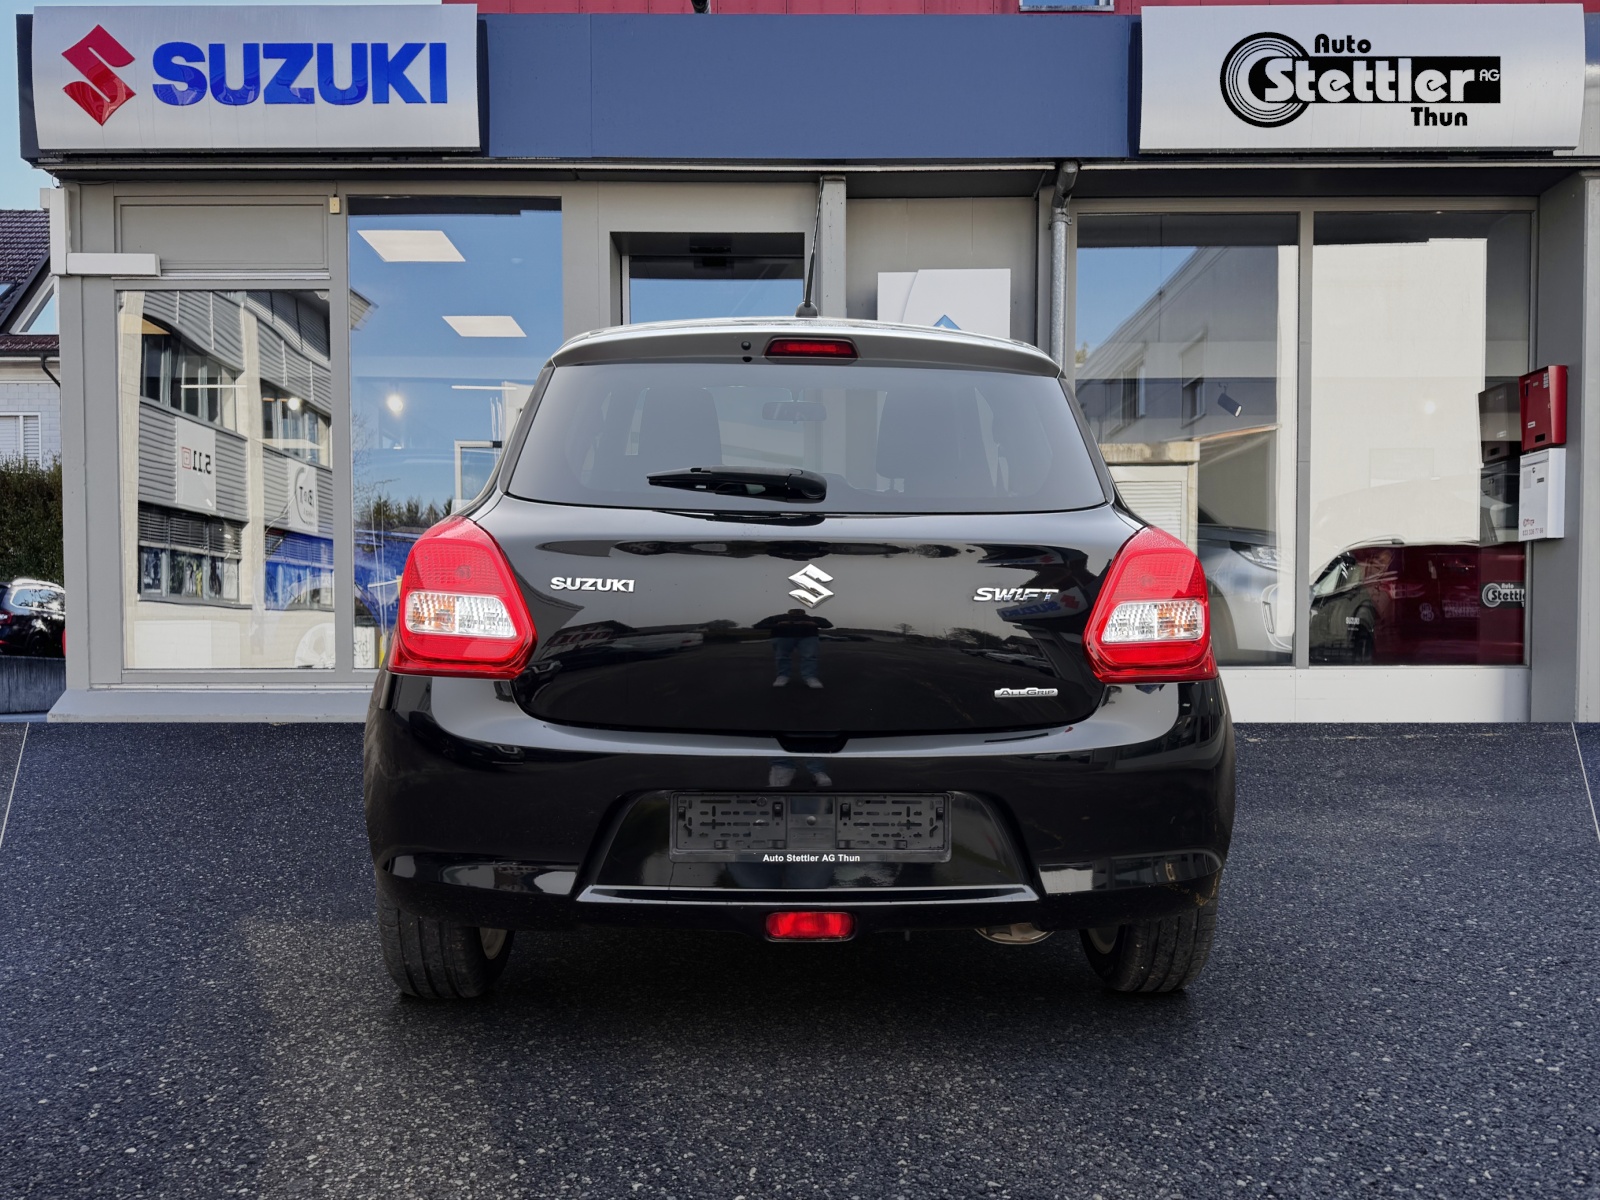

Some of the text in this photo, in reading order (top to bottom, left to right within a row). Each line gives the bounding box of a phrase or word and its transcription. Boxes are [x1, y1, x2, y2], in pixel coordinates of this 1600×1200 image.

[1314, 33, 1372, 53] Auto
[152, 41, 447, 105] SUZUKI
[1264, 57, 1500, 103] Stettler AG
[1410, 106, 1468, 126] Thun
[550, 576, 635, 592] SUZUKI
[973, 587, 1060, 602] SWIFT
[762, 853, 860, 862] Auto Stettler AG Thun
